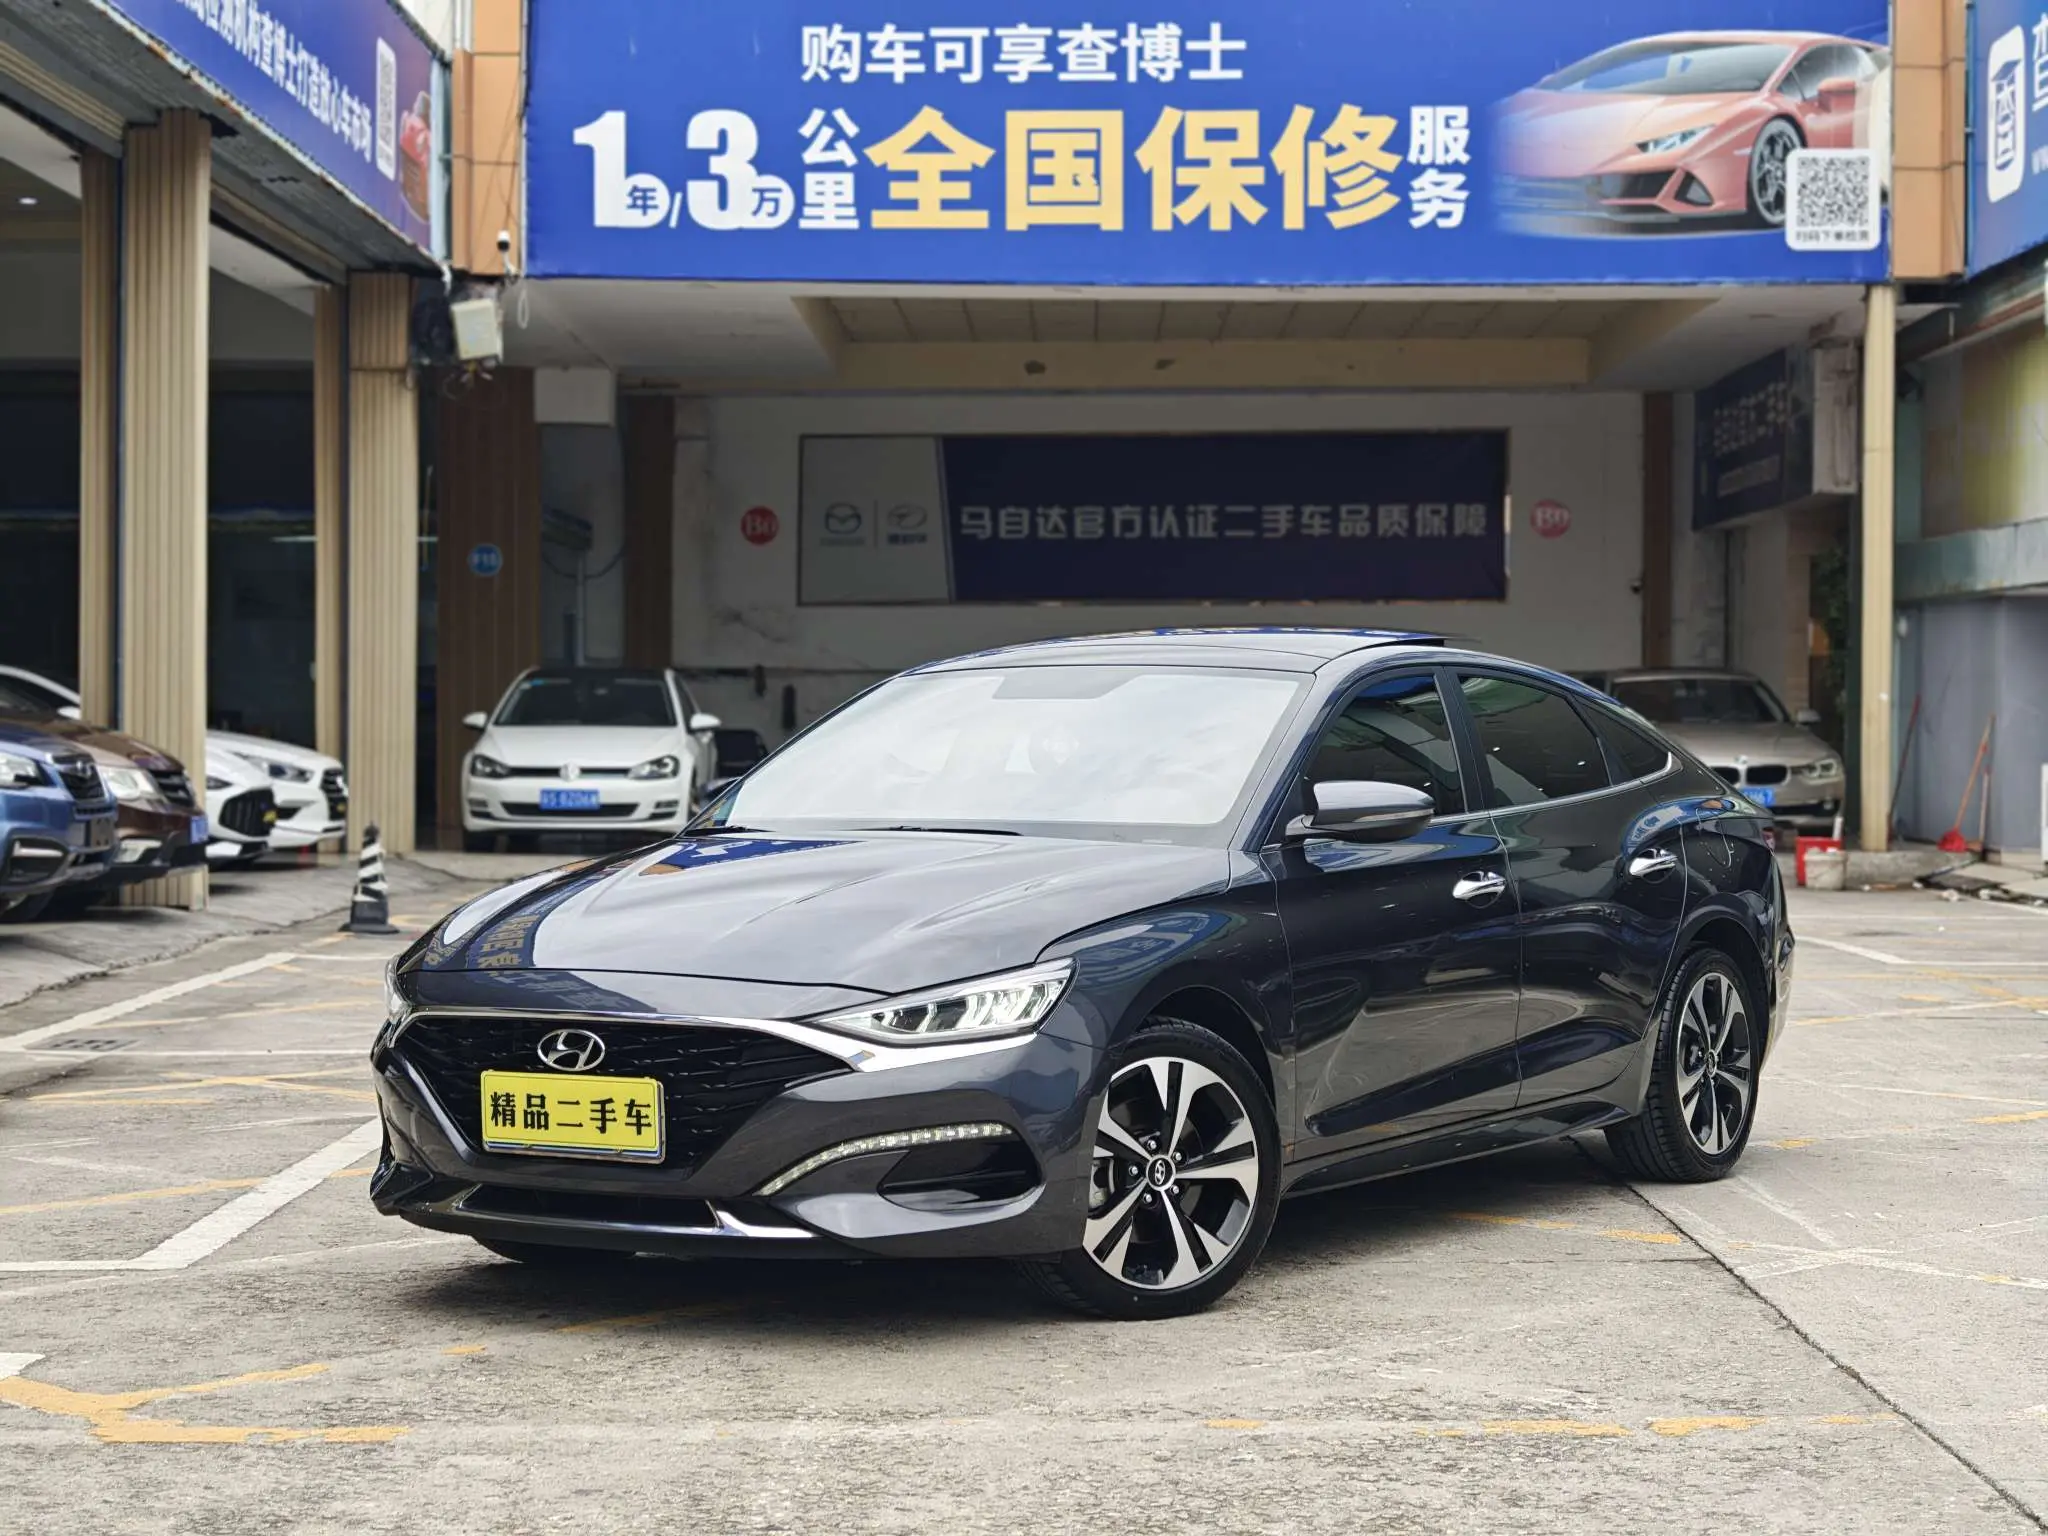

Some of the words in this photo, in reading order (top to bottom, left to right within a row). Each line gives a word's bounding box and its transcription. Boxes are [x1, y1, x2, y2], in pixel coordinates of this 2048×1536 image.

[801, 22, 1247, 84] 购车可享查博士
[960, 503, 1487, 539] 马自达官方认证二手车品质保障
[489, 1091, 653, 1136] 精品二手车
